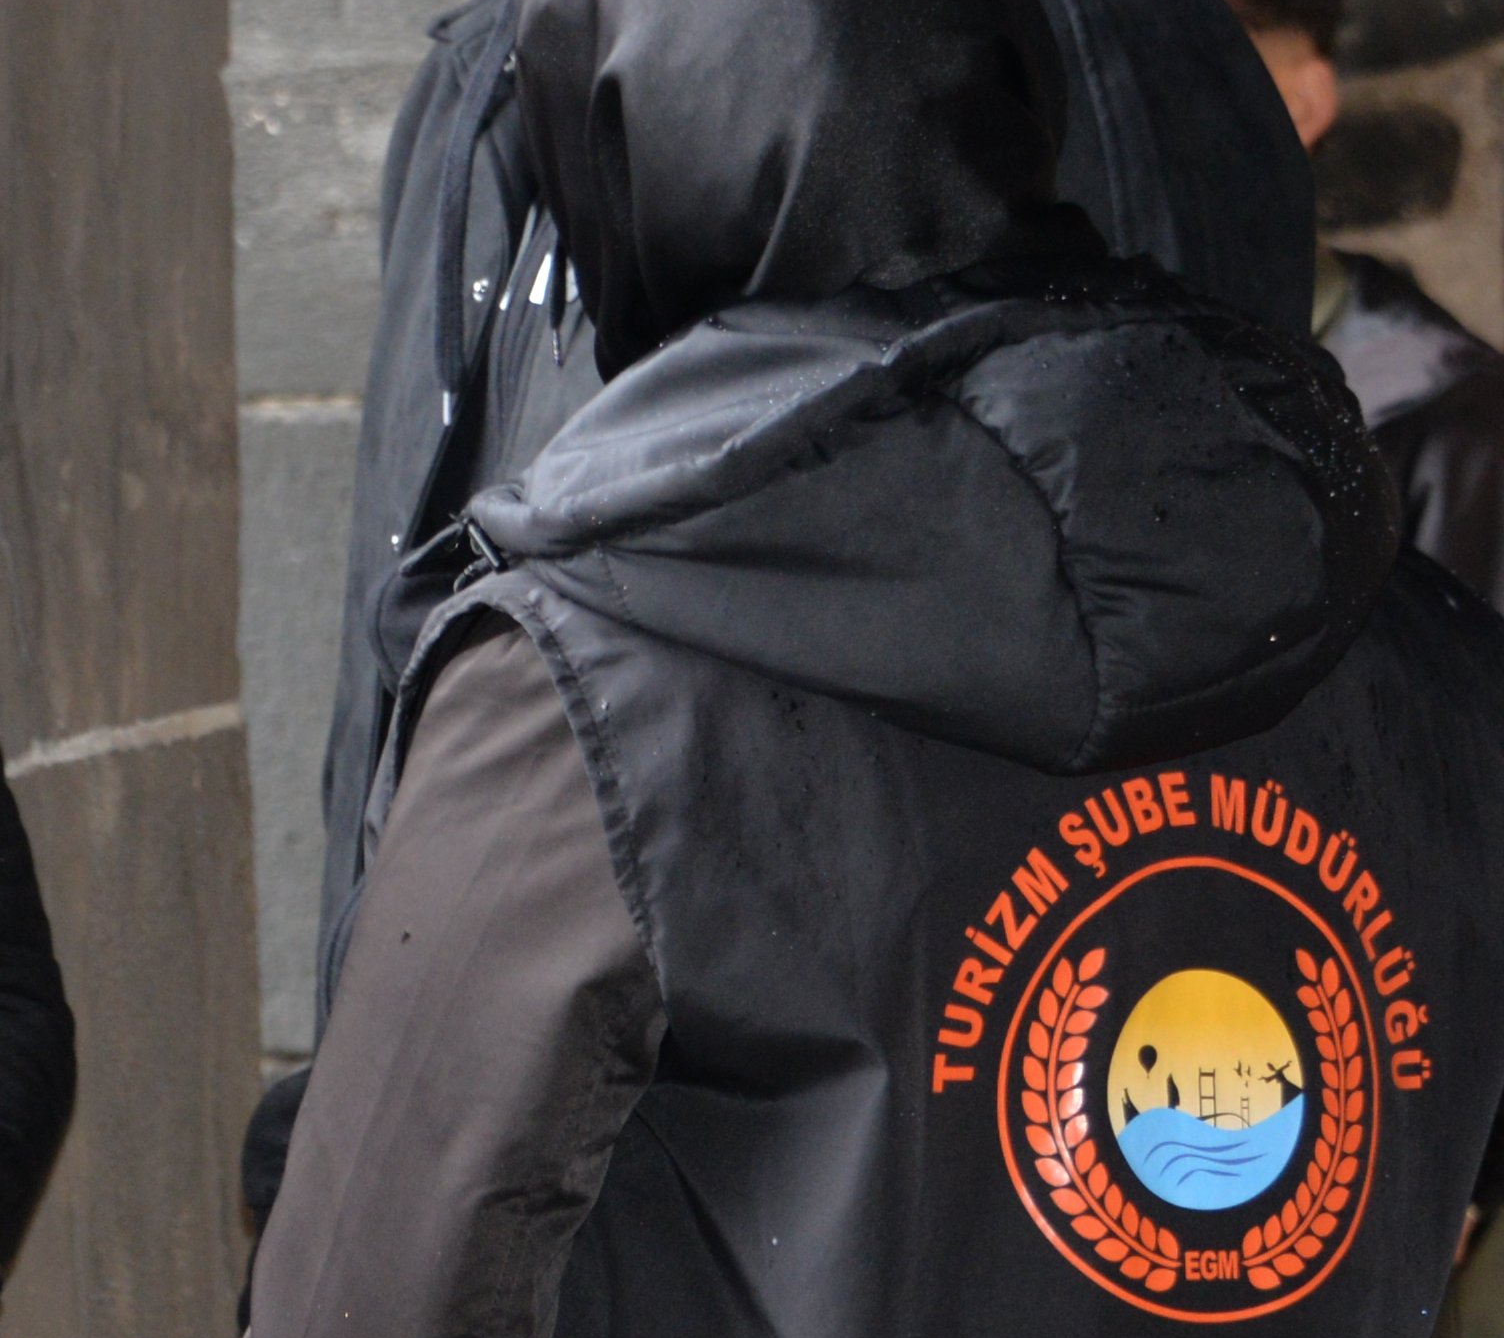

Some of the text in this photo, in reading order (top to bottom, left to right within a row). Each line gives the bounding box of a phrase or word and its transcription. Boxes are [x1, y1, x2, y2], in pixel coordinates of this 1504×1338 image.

[931, 771, 1434, 1093] TURİZM ŞUBE MÜDÜRLÜĞÜ
[1183, 1249, 1240, 1282] EGM
